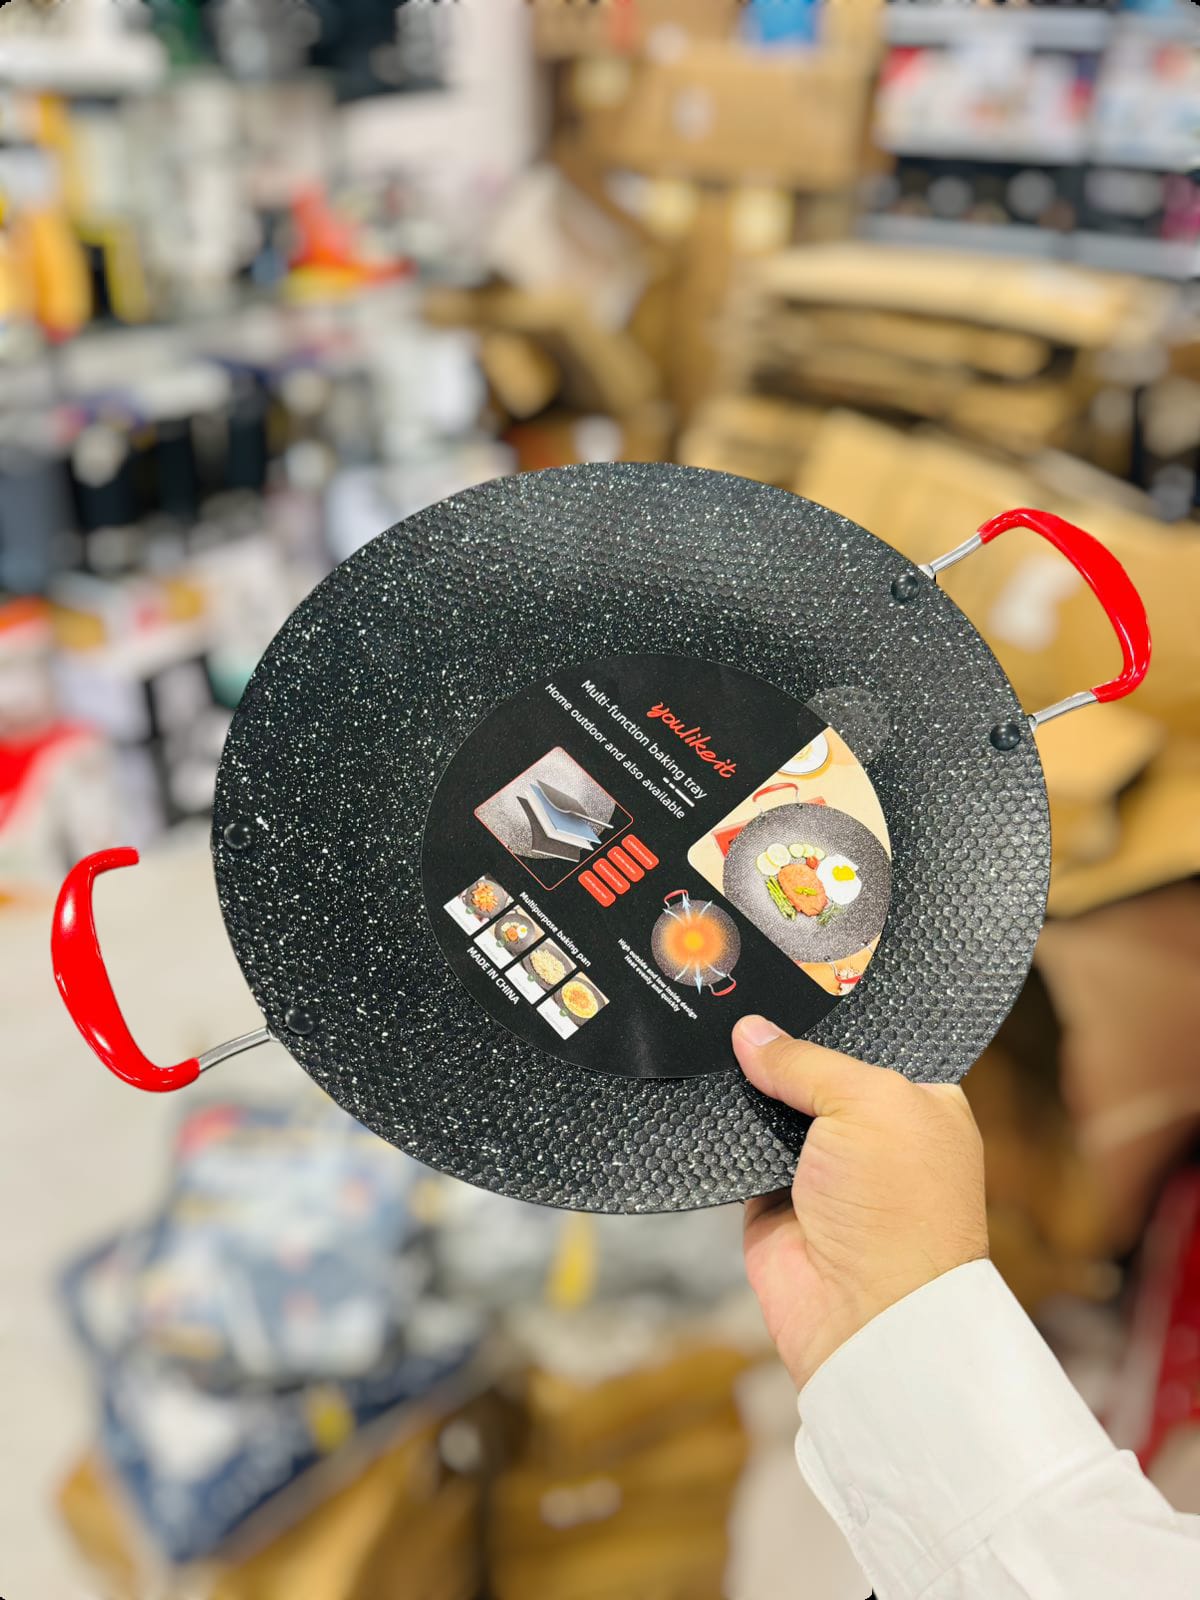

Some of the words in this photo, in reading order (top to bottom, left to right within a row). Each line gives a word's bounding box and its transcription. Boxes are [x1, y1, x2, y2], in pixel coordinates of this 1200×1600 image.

[545, 683, 571, 710] Home
[571, 709, 607, 743] outdoor
[605, 743, 626, 761] and
[622, 760, 644, 780] also
[642, 779, 685, 819] available
[581, 680, 650, 746] Multi-function
[648, 743, 685, 781] baking
[683, 777, 707, 799] tray
[646, 702, 736, 778] youlikeit
[519, 891, 558, 933] Multipurpose
[556, 930, 579, 955] baking
[576, 952, 591, 967] pan
[467, 946, 490, 971] MADE
[487, 968, 499, 980] IN
[495, 979, 520, 1005] CHINA
